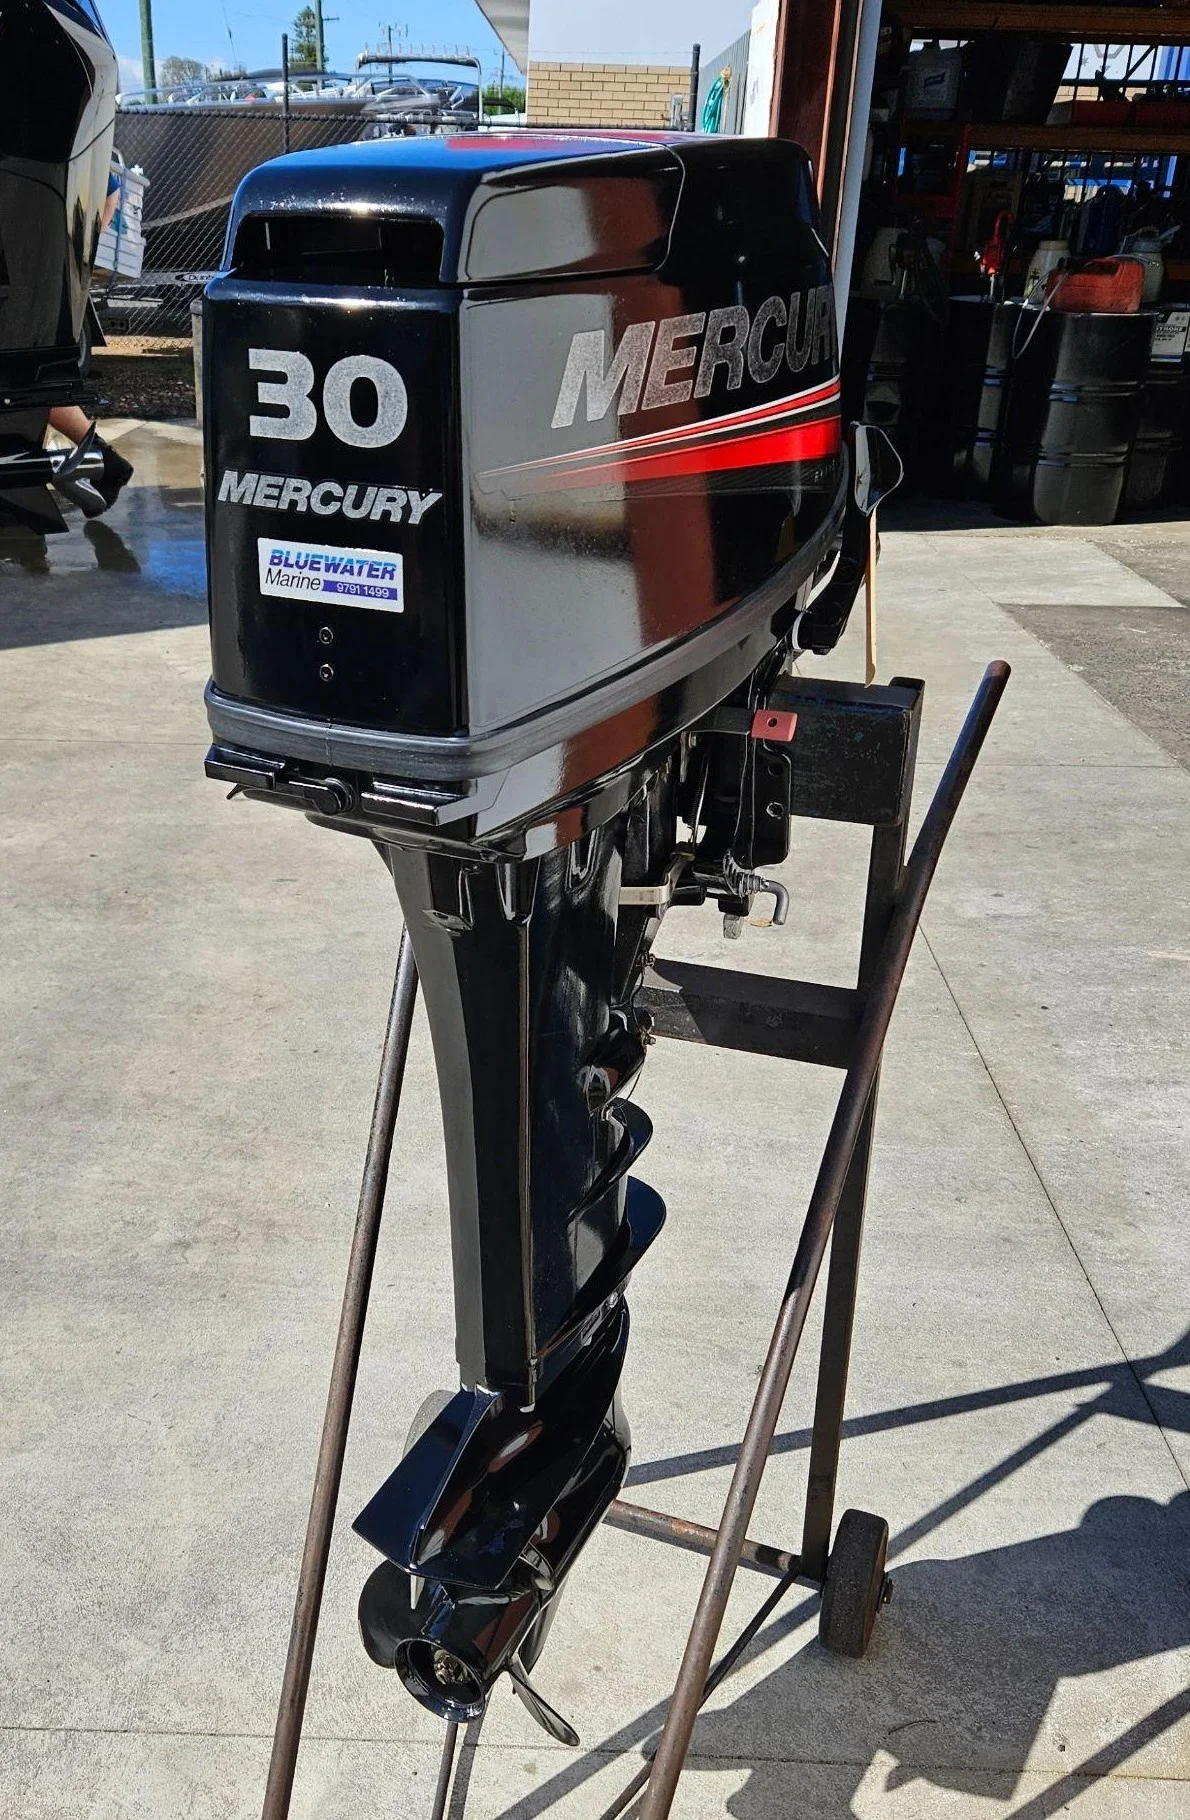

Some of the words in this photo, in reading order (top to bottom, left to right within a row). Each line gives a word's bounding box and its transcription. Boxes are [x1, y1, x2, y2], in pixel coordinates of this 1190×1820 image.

[550, 284, 834, 429] MERCUR
[248, 348, 408, 449] 30
[217, 470, 443, 525] MERCURY
[265, 567, 321, 590] Marine
[336, 582, 360, 594] 9791
[363, 585, 389, 598] 1499
[269, 549, 397, 580] BLUEWATER
